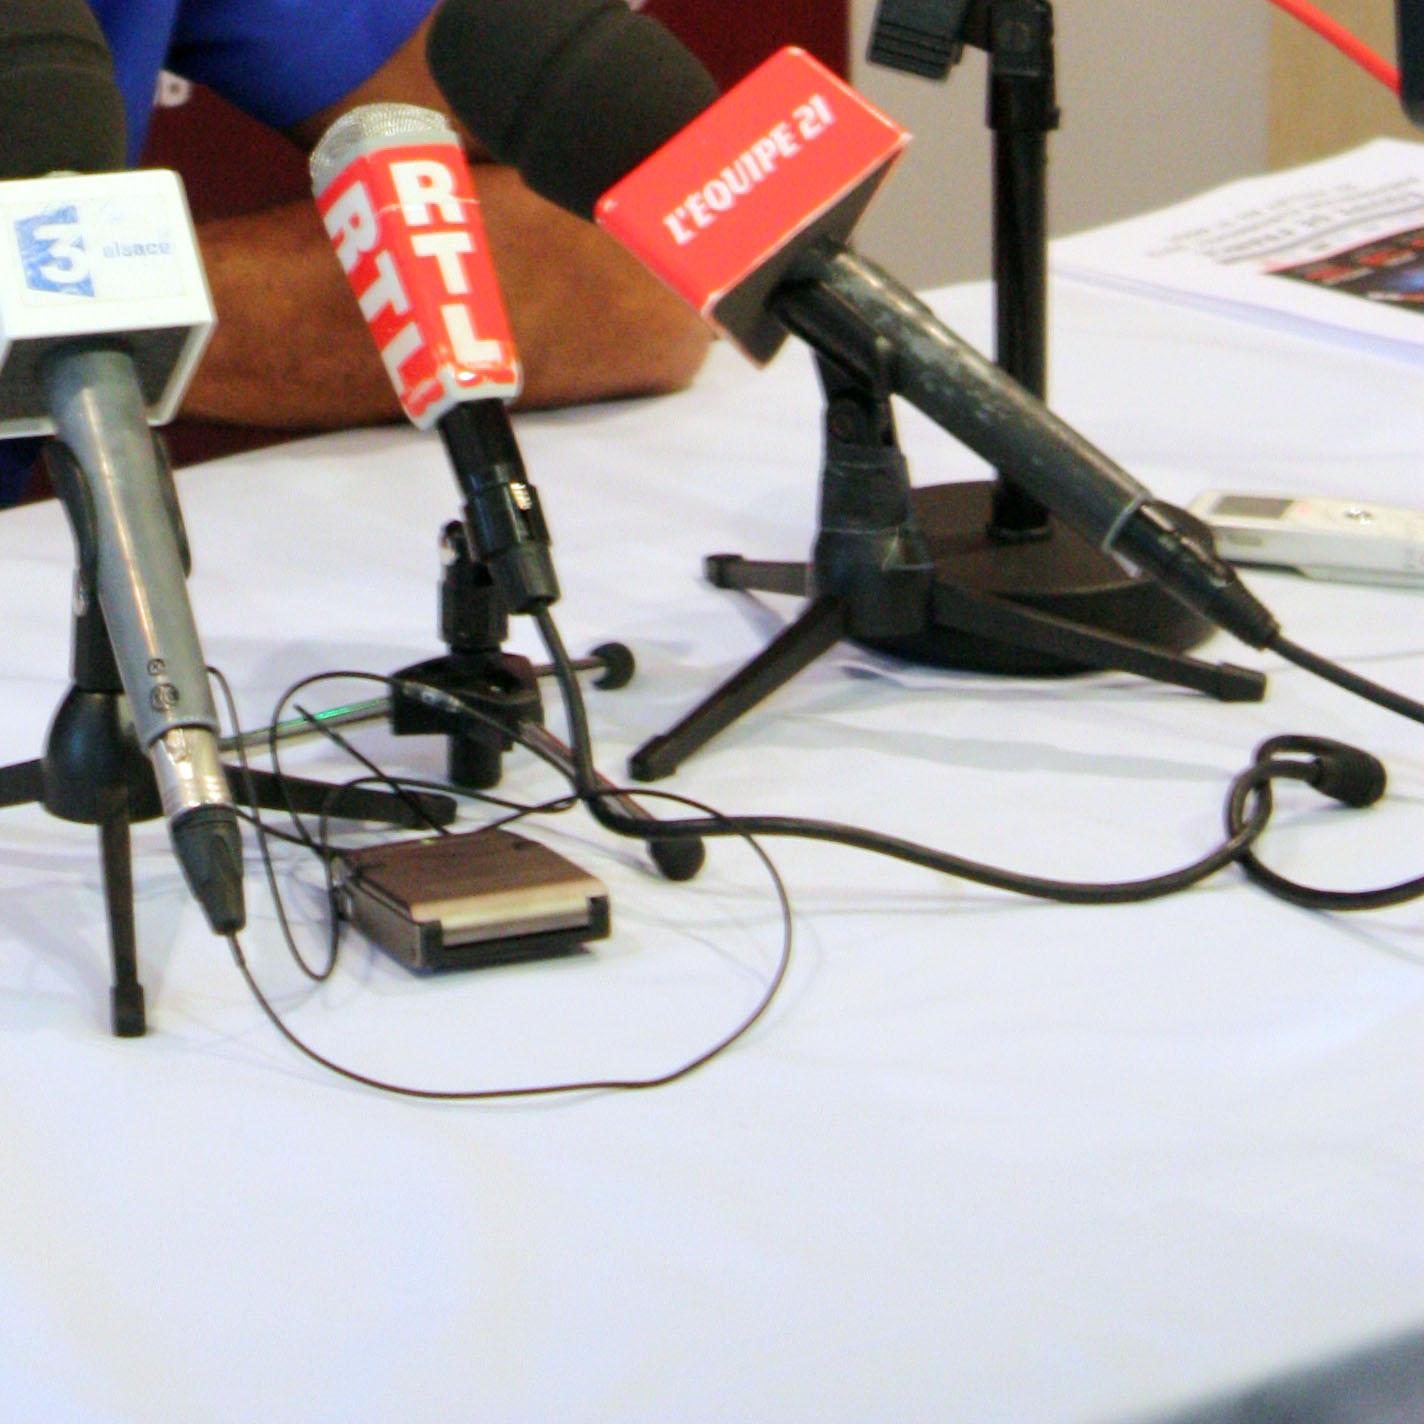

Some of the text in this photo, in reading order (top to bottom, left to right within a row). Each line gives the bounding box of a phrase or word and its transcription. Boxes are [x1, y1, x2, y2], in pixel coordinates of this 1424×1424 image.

[33, 222, 91, 285] 3
[662, 94, 837, 246] L'EQUIPE 21
[323, 181, 426, 398] RTL
[389, 159, 504, 366] RTL
